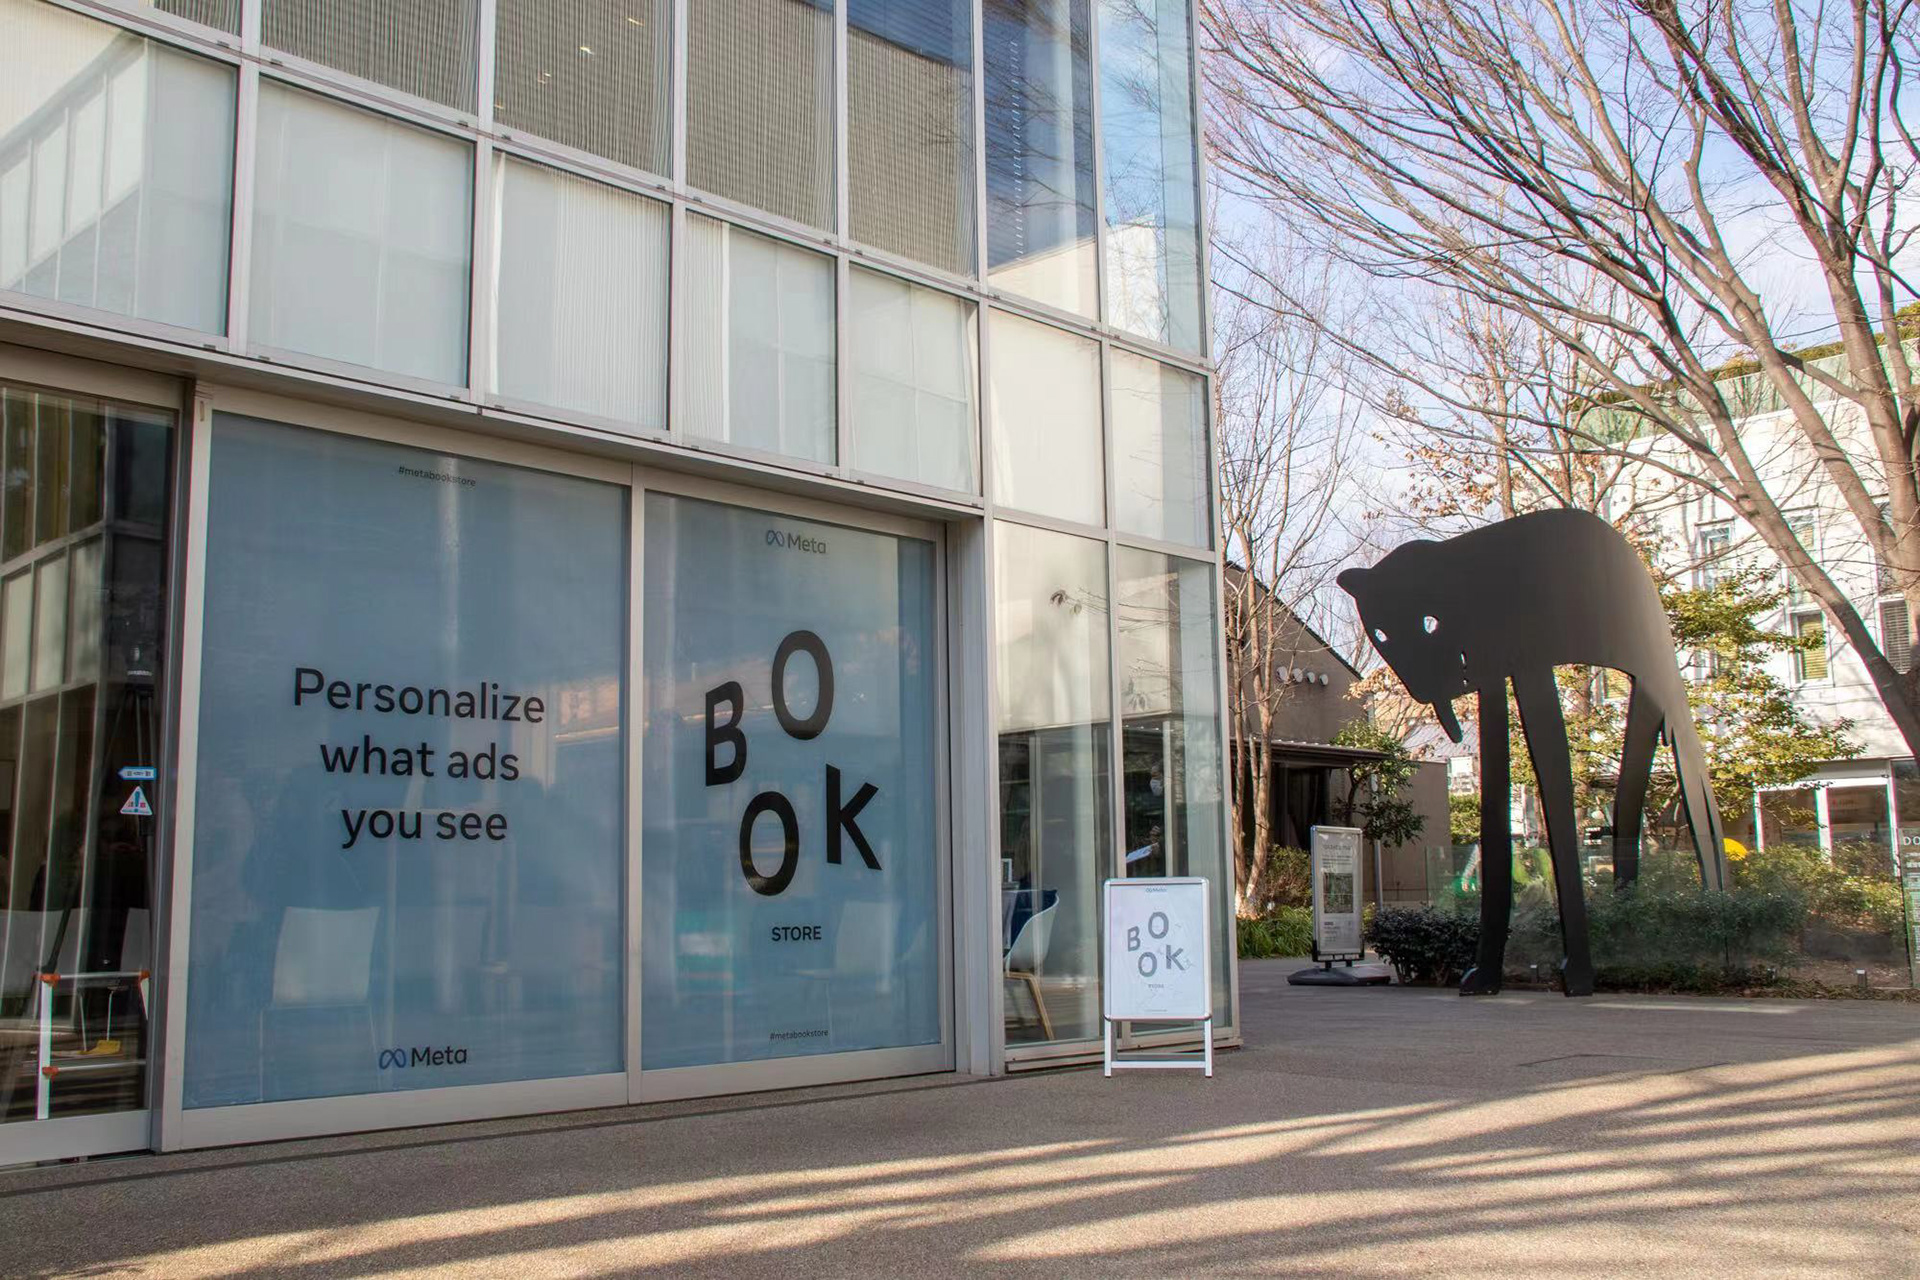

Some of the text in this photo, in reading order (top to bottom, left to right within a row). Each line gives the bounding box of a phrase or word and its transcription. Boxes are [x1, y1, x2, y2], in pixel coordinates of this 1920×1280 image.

[398, 466, 476, 487] #metabookstore
[787, 532, 827, 554] Meta
[294, 667, 545, 723] Personalize
[320, 734, 519, 781] what ads
[341, 809, 508, 850] you see
[771, 926, 822, 941] STORE
[769, 1029, 829, 1041] #metabookstore
[411, 1045, 468, 1068] Meta
